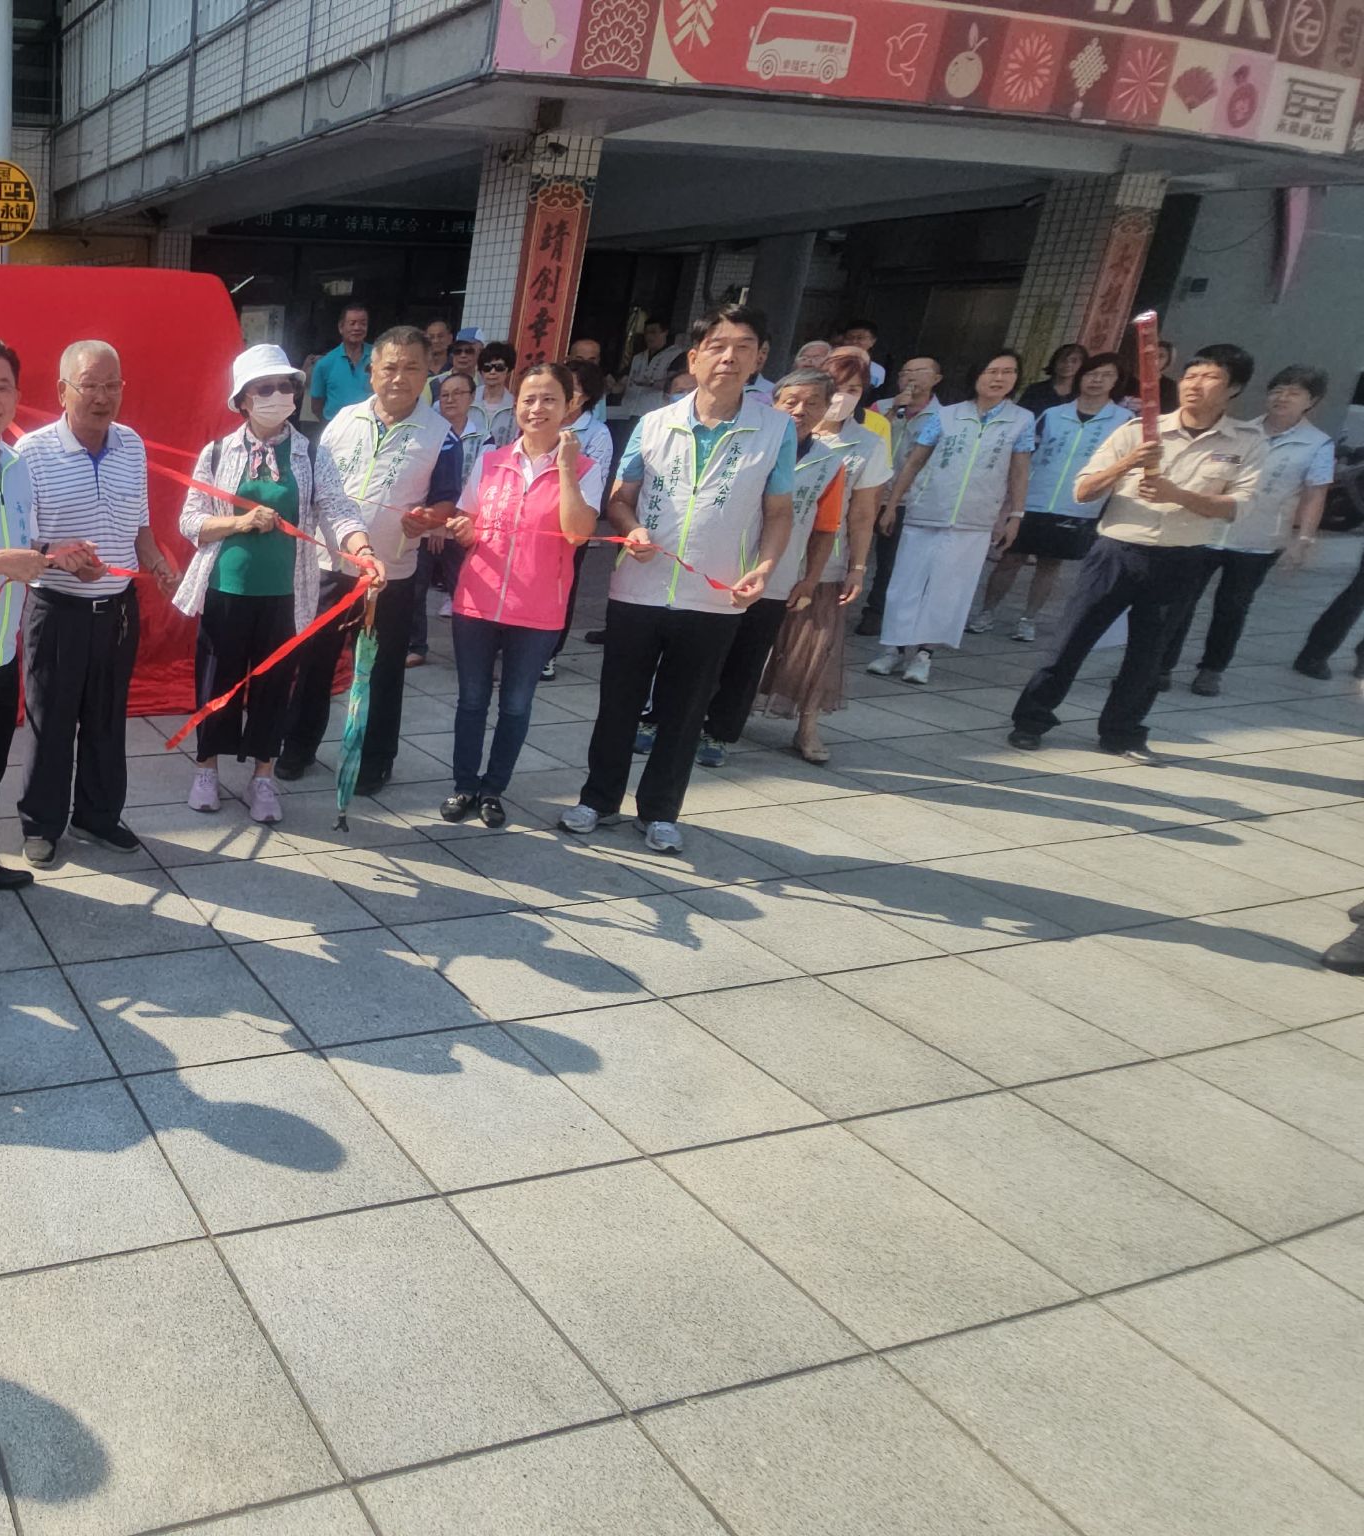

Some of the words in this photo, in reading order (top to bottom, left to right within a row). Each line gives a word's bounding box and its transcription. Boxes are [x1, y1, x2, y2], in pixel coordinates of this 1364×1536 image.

[667, 455, 682, 497] 永西村長
[712, 442, 742, 509] 永靖鄉公所
